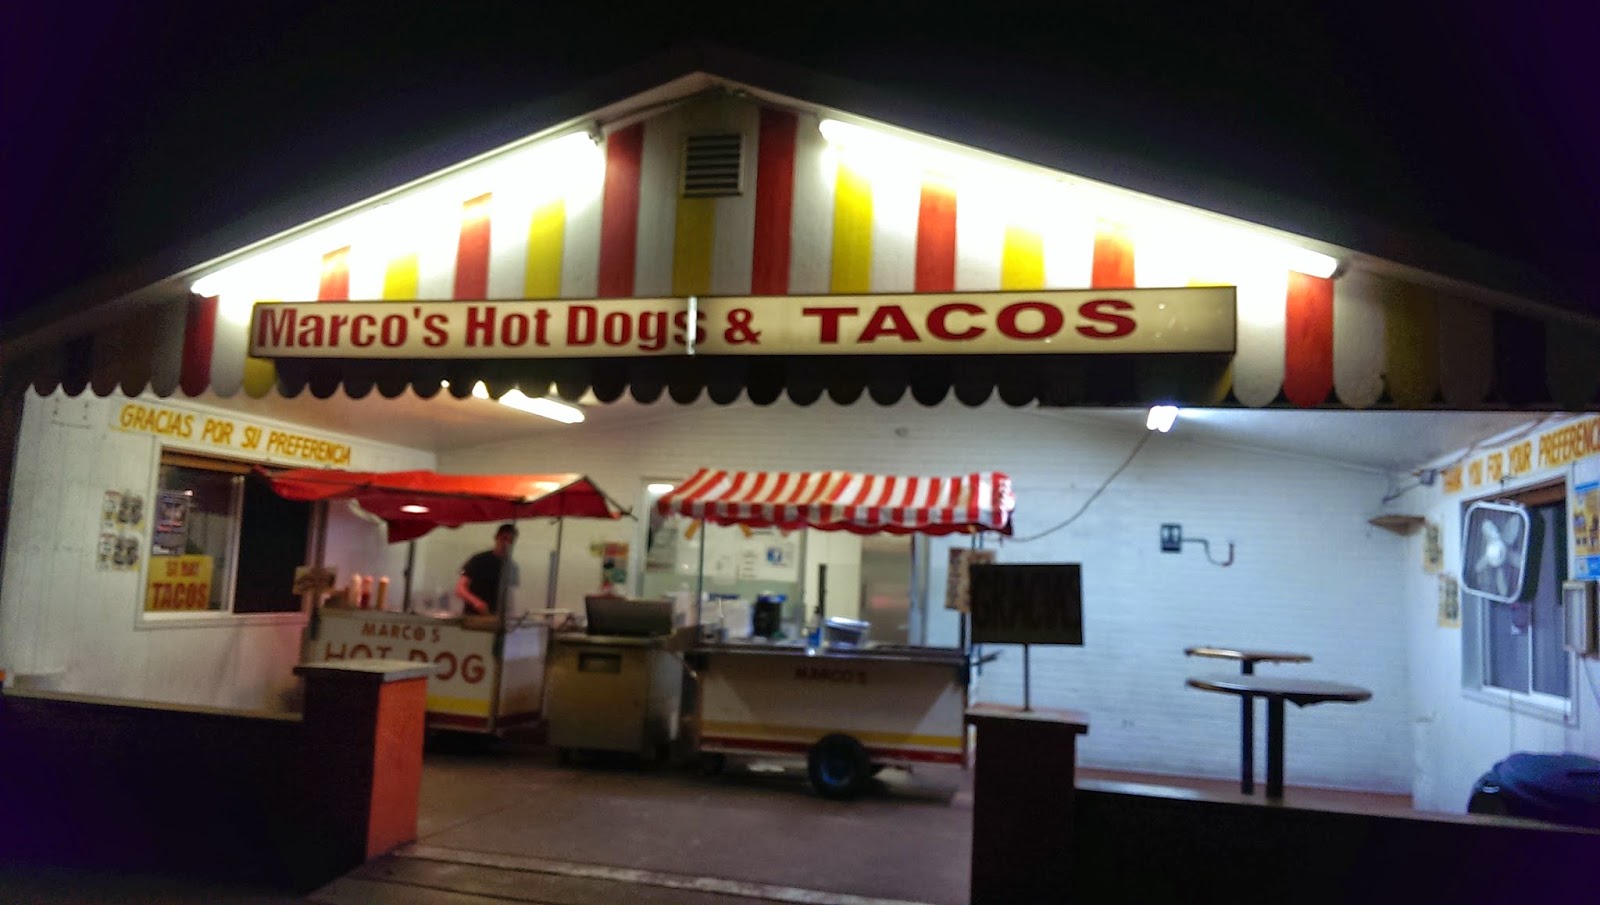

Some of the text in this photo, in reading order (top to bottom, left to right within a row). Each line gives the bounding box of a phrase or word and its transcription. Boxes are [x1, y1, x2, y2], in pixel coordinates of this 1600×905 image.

[257, 299, 1138, 351] Marco's Hot Dogs & TACOS
[119, 403, 352, 465] GRACIAS POR SU PREFERENCIA
[152, 582, 208, 609] TACOS
